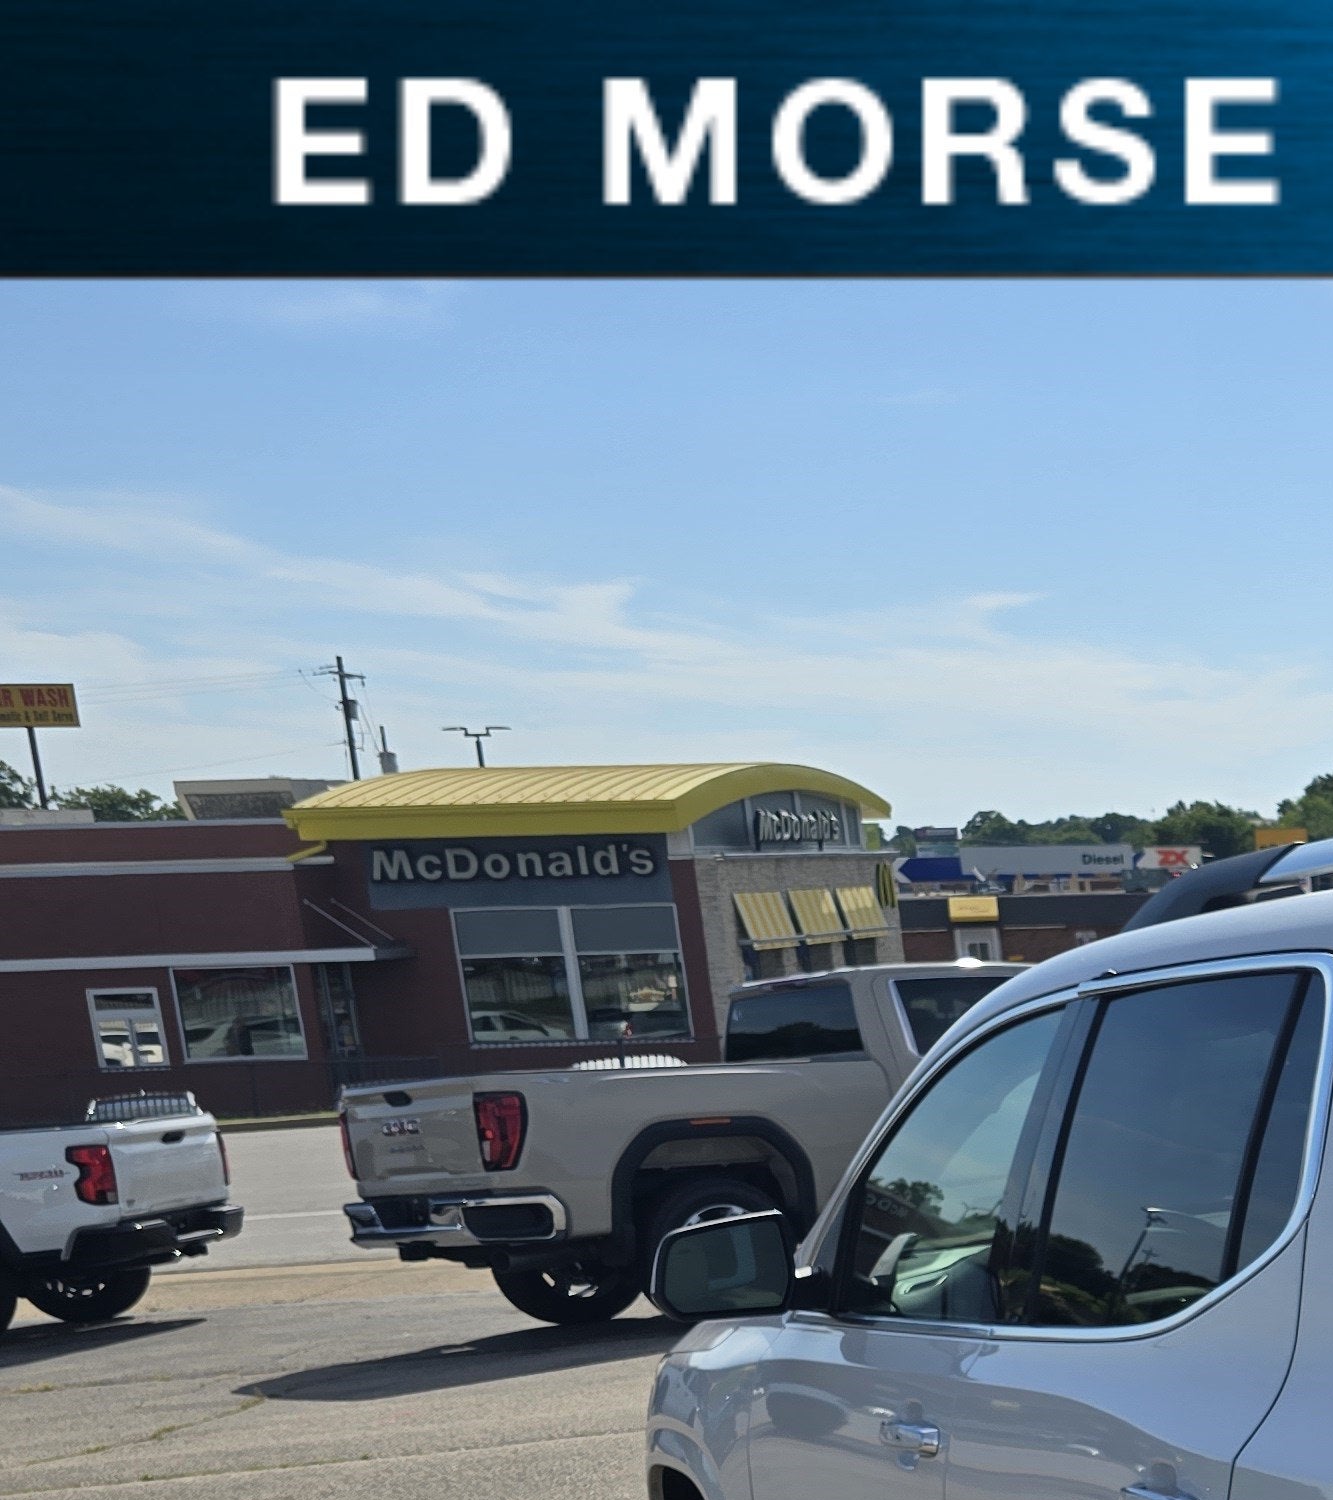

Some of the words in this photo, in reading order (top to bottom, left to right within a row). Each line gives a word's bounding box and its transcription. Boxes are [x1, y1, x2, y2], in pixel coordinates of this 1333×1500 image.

[19, 688, 70, 707] WASH
[755, 807, 840, 842] McDonald's
[371, 843, 655, 881] McDonald's
[1081, 852, 1125, 866] Diesel
